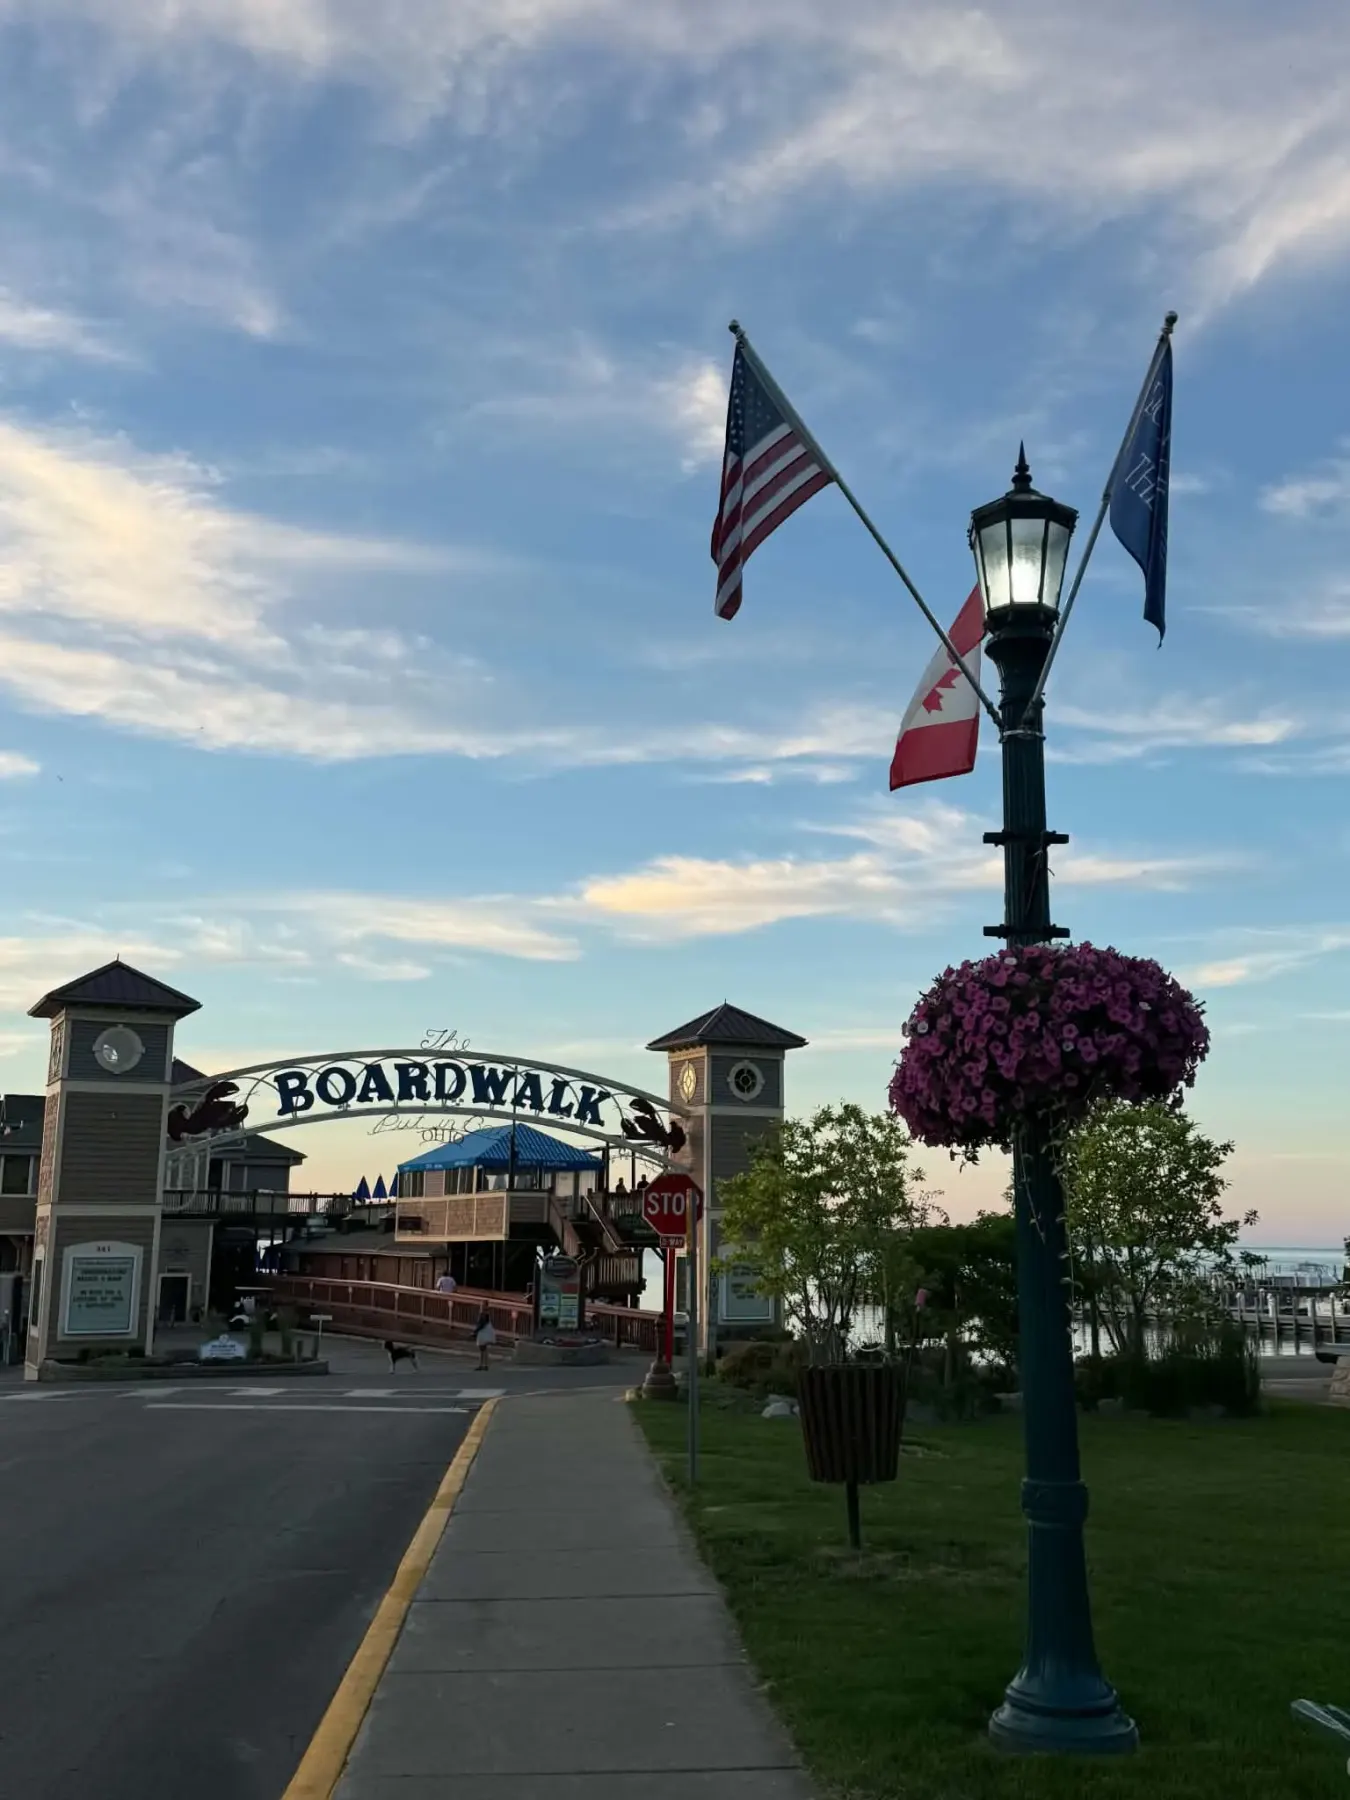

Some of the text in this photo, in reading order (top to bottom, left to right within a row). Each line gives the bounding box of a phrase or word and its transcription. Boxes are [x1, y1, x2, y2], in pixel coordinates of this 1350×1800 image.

[420, 1029, 471, 1051] The
[274, 1061, 612, 1127] BOARDWALK
[367, 1113, 425, 1135] Put
[420, 1128, 465, 1145] OHIO
[647, 1192, 700, 1216] STO
